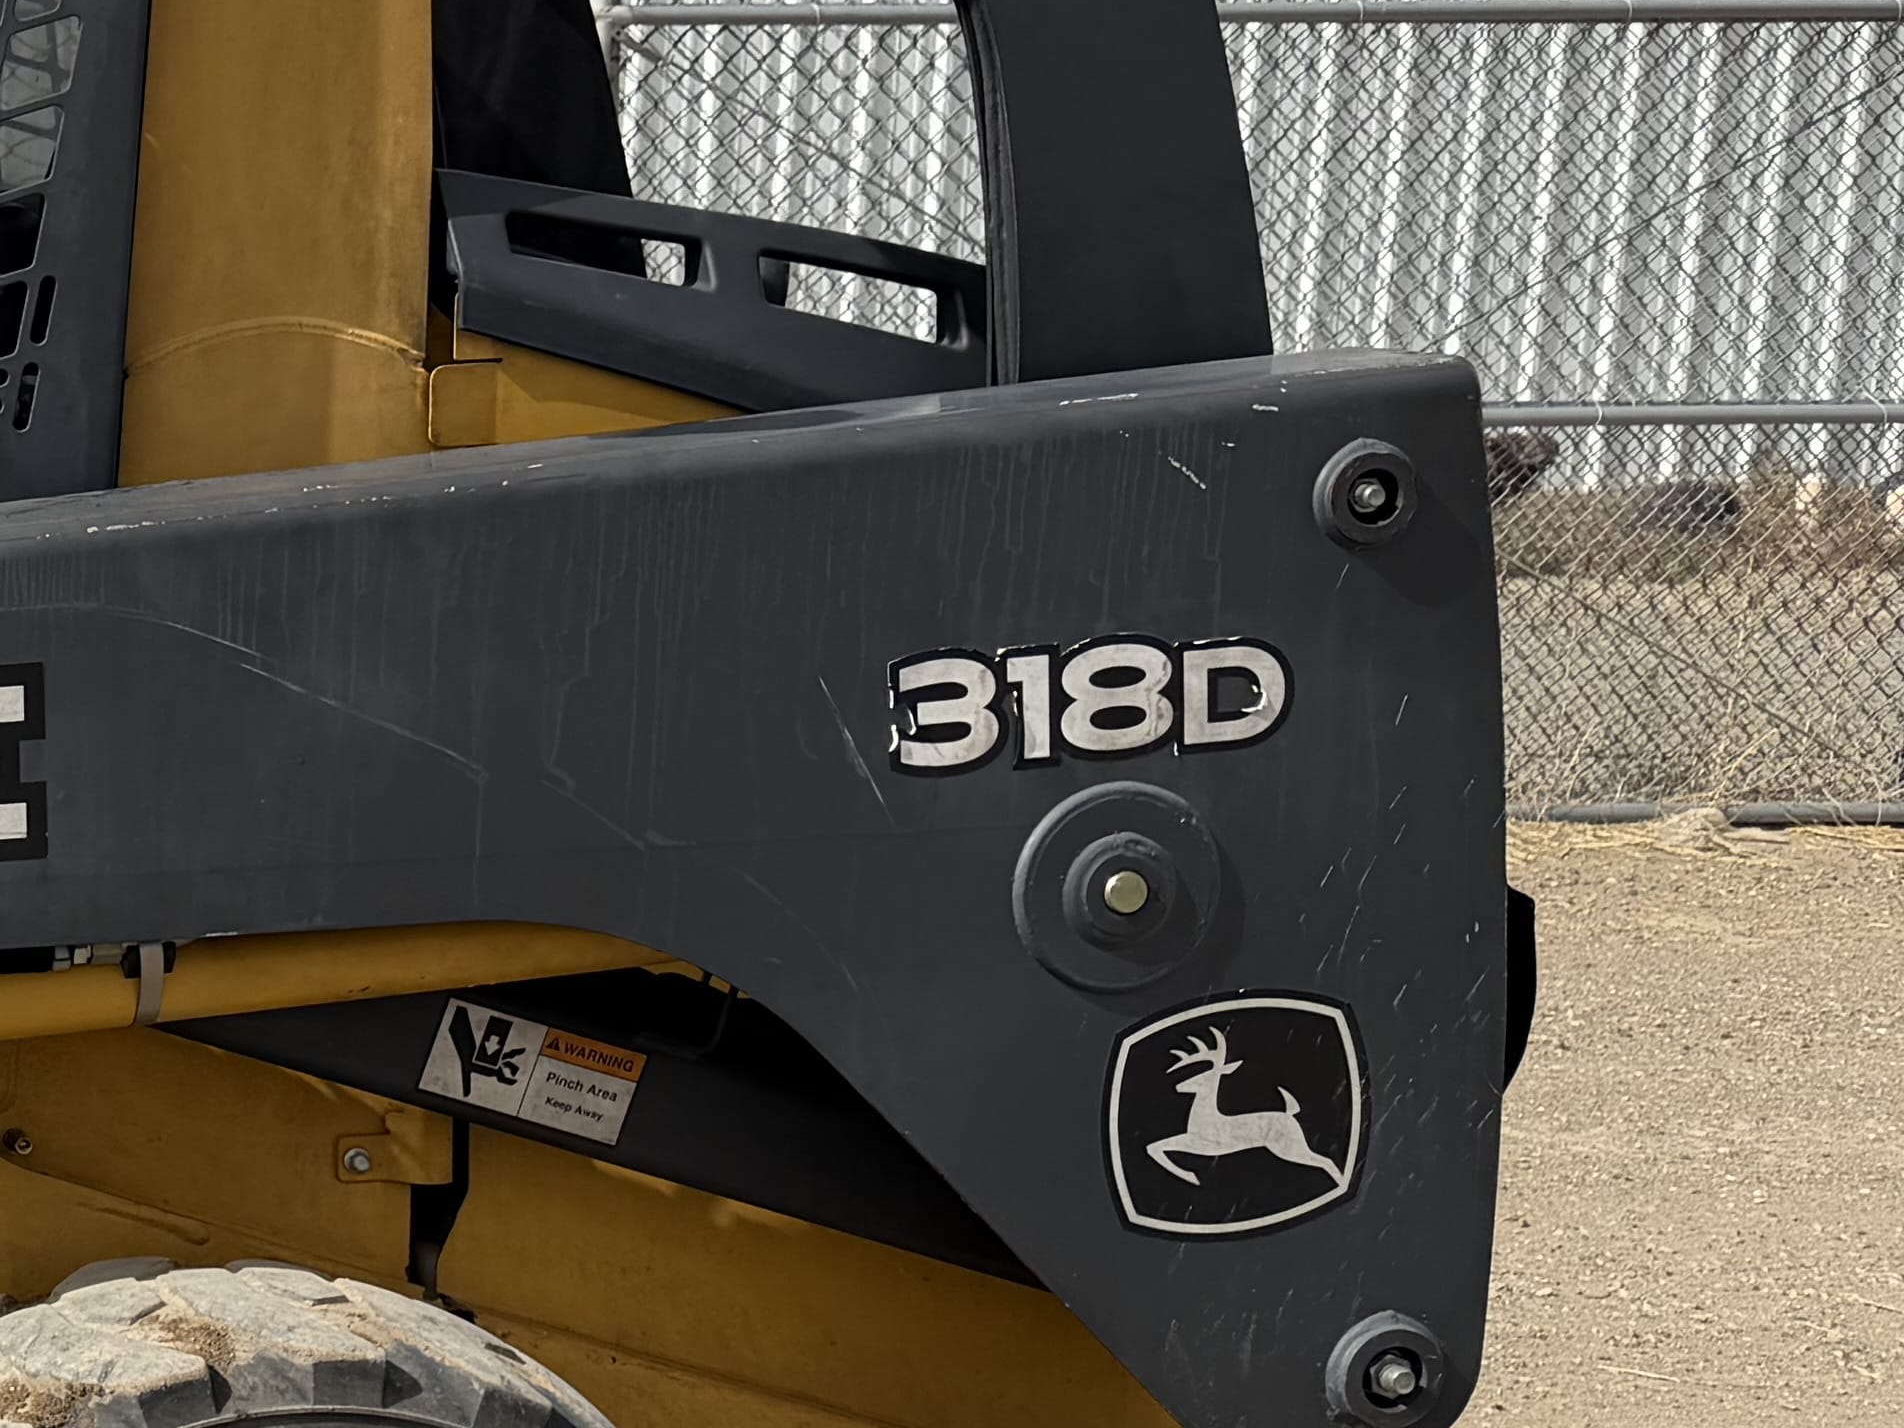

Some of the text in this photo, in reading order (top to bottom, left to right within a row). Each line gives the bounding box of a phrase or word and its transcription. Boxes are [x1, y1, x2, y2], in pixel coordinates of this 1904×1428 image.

[892, 640, 1286, 769] 318D
[564, 1042, 634, 1072] WARNING
[545, 1070, 618, 1103] Pinch Area
[545, 1096, 603, 1123] Keep Away
